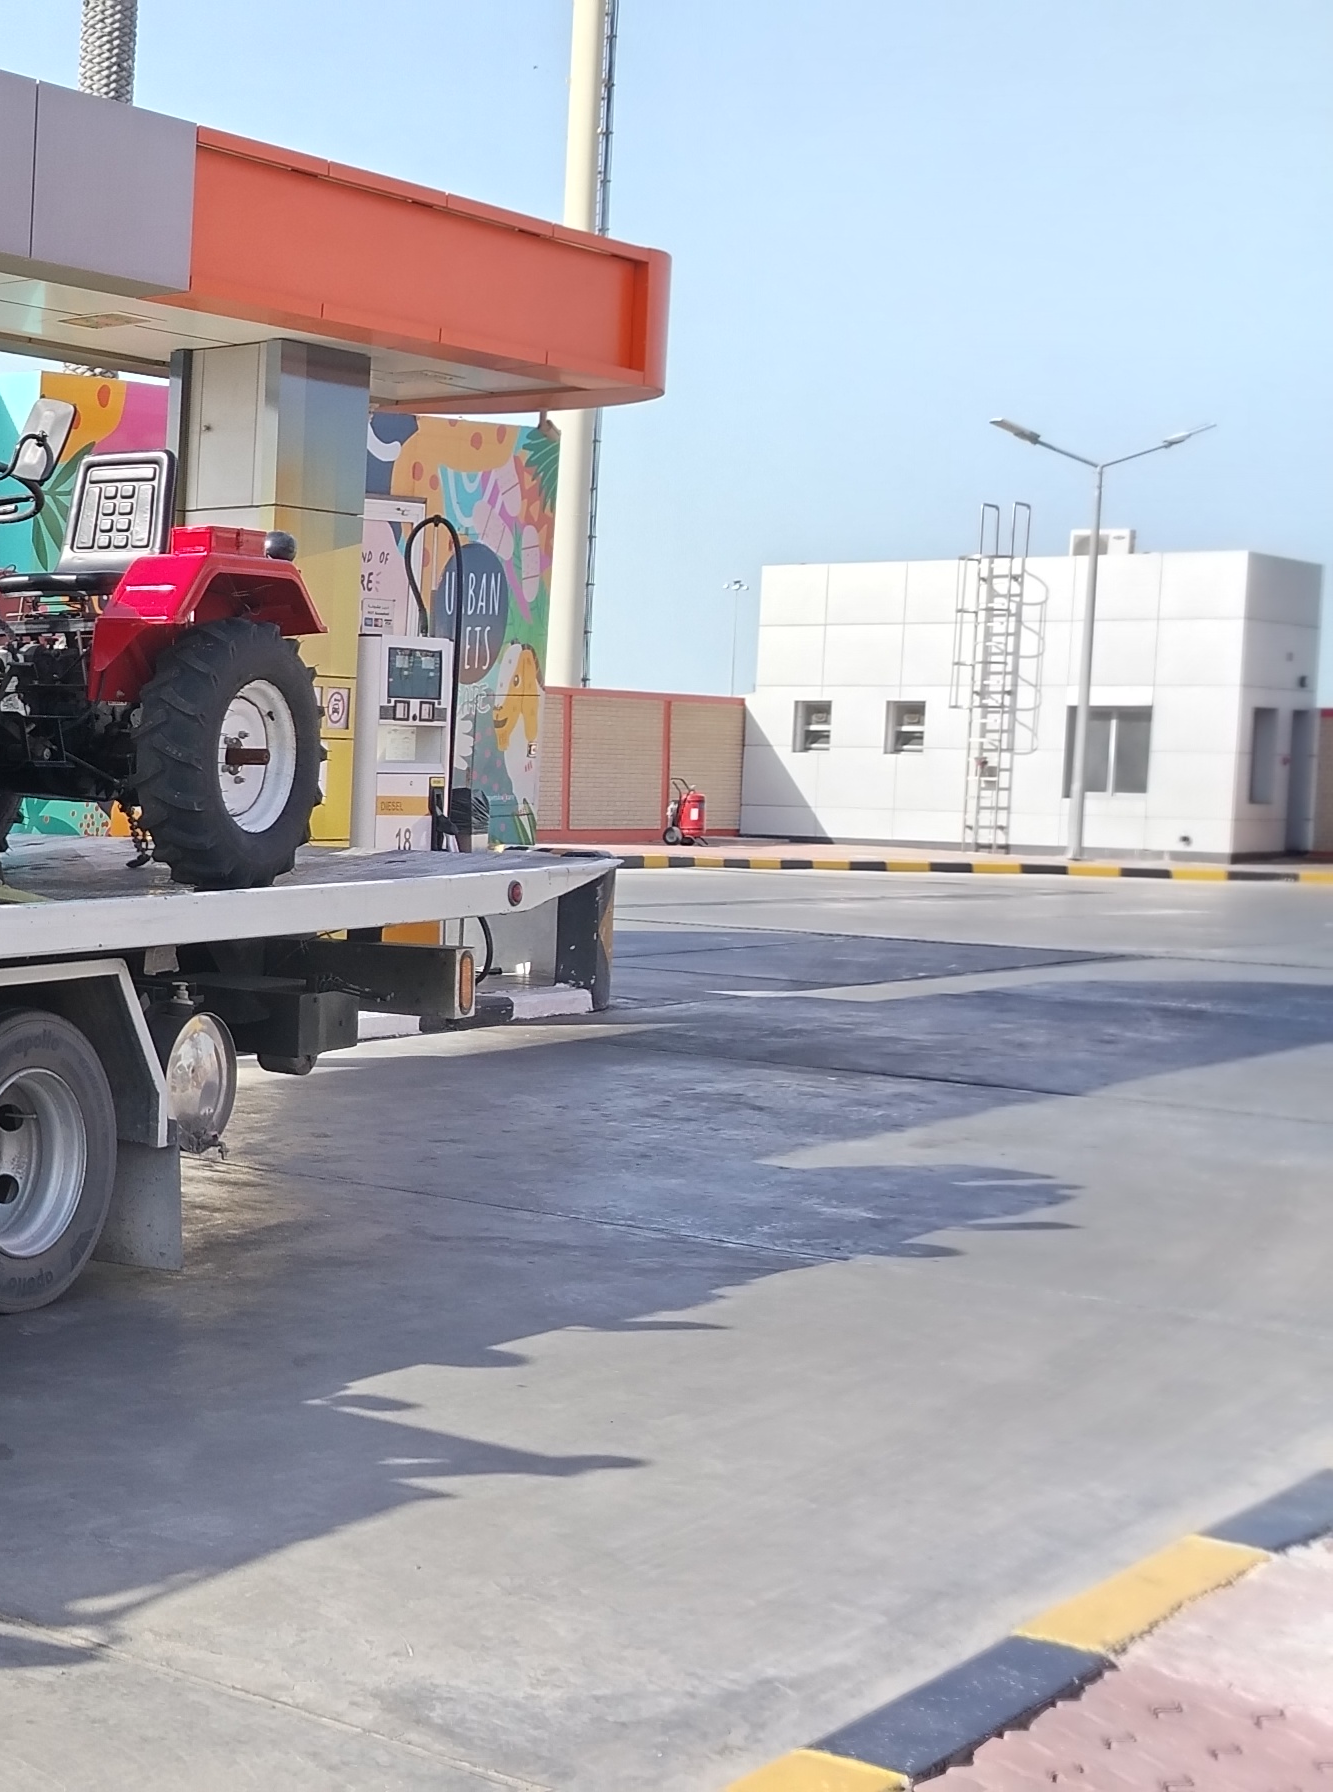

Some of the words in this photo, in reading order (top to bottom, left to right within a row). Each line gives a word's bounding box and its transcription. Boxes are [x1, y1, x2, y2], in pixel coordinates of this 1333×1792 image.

[378, 550, 390, 566] OF
[444, 571, 501, 617] UBAN
[464, 625, 492, 671] ETS
[380, 801, 404, 812] DIESEL
[395, 827, 412, 851] 18
[13, 1028, 61, 1058] apollo
